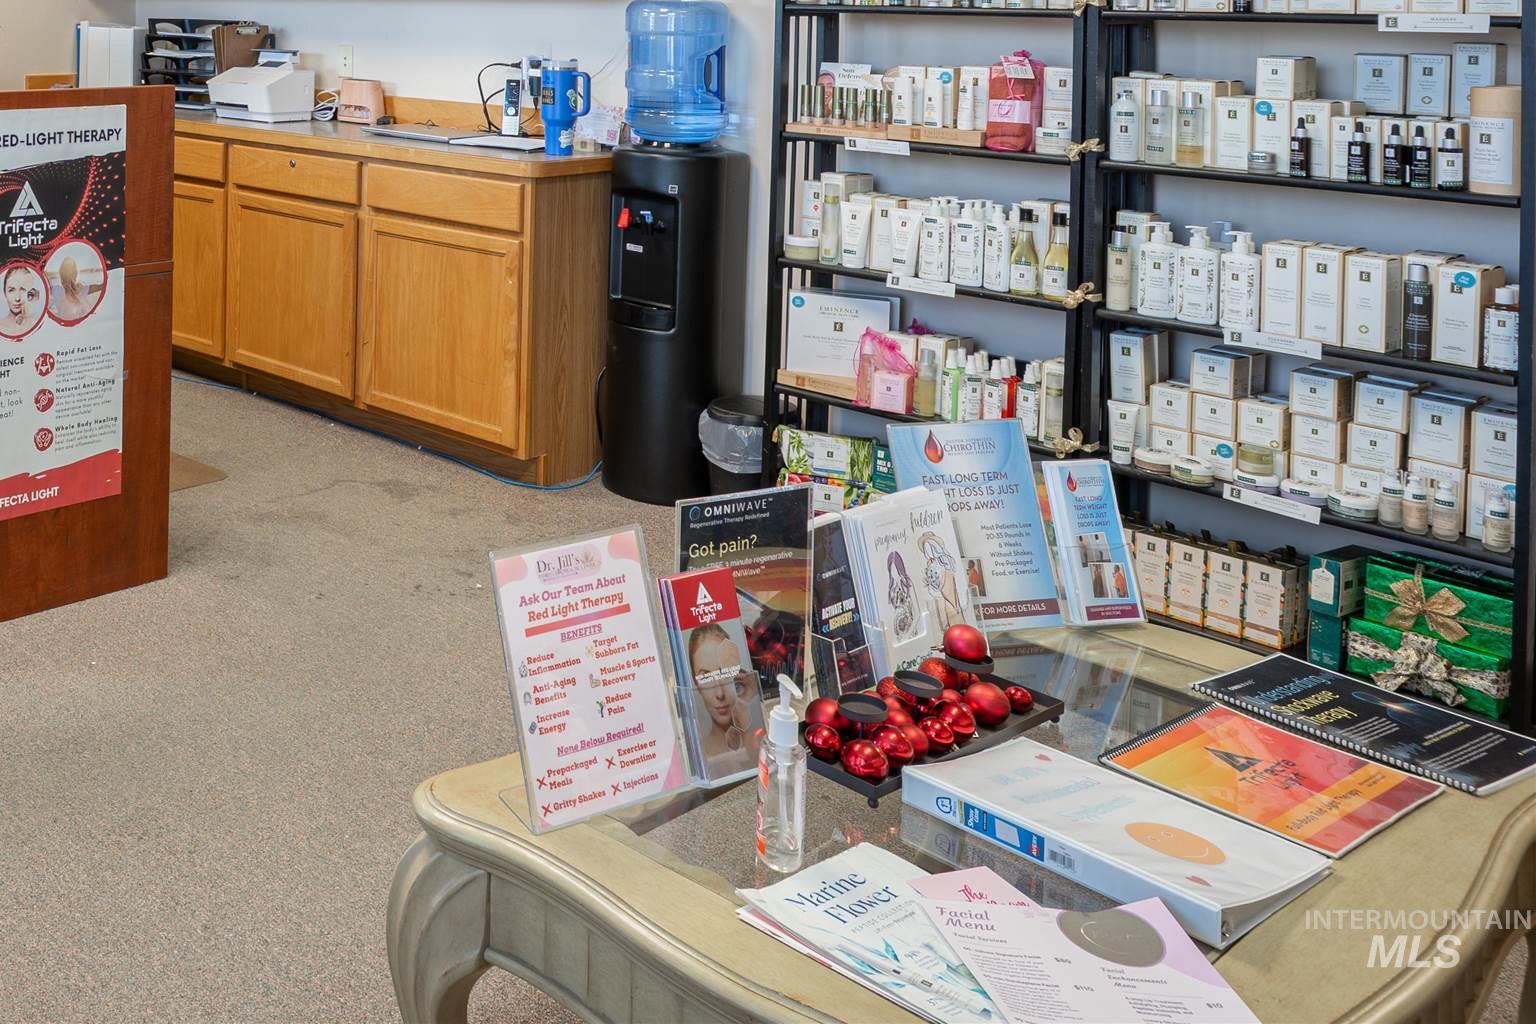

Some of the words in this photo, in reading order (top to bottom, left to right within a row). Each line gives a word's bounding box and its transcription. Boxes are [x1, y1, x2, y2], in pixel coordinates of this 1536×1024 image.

[67, 128, 122, 144] THERAPY
[8, 233, 44, 249] Light
[944, 441, 996, 452] CHIROTHIN
[922, 474, 947, 485] FAST,
[949, 473, 979, 483] LONG
[982, 472, 1008, 481] TERM
[31, 486, 59, 502] LIGHT
[959, 486, 984, 497] LOSS
[986, 485, 994, 495] IS
[997, 484, 1019, 494] JUST
[974, 499, 1004, 511] AWAY!
[690, 519, 723, 529] Regenerative
[724, 516, 744, 524] Therapy
[745, 512, 770, 520] Redefined
[688, 543, 714, 558] Got
[719, 534, 758, 557] pain?
[537, 559, 554, 573] Dr.
[556, 553, 581, 570] Jill's
[519, 590, 540, 608] Ask
[542, 588, 563, 603] Our
[564, 582, 593, 599] Team
[595, 574, 626, 592] About
[527, 607, 548, 622] Red
[551, 599, 579, 618] Light
[580, 591, 624, 611] Therapy
[690, 602, 722, 616] Trifecta
[982, 606, 995, 615] FOR
[997, 605, 1017, 613] MORE
[1018, 602, 1046, 611] DETAILS
[698, 613, 716, 623] Light
[560, 624, 602, 642] BENEFITS
[593, 635, 618, 649] Target
[624, 641, 639, 652] Fat
[526, 651, 555, 665] Reduce
[528, 656, 581, 676] Inflammation
[600, 662, 626, 677] Muscle
[627, 659, 632, 669] &
[633, 655, 656, 671] Sports
[532, 676, 577, 695] Anti-Aging
[602, 672, 636, 688] Recovery
[1240, 674, 1332, 706] Understanding
[534, 691, 567, 706] Benefits
[605, 691, 632, 706] Reduce
[1271, 690, 1340, 715] Shockwave
[536, 708, 570, 724] Increase
[607, 704, 625, 717] Pain
[1297, 706, 1358, 726] Therapy
[538, 721, 567, 737] Energy
[556, 741, 579, 758] None
[580, 734, 606, 750] Below
[606, 723, 645, 744] Required!
[617, 741, 647, 758] Exercise
[649, 741, 657, 750] or
[547, 757, 599, 779] Prepackaged
[619, 751, 657, 770] Downtime
[549, 777, 573, 791] Meals
[623, 772, 659, 791] Injections
[553, 796, 577, 814] Gritty
[578, 789, 607, 806] Shakes
[784, 870, 867, 912] Marine
[957, 884, 988, 903] The
[823, 885, 900, 925] Flower
[936, 906, 990, 921] Facial
[945, 916, 997, 932] Menu
